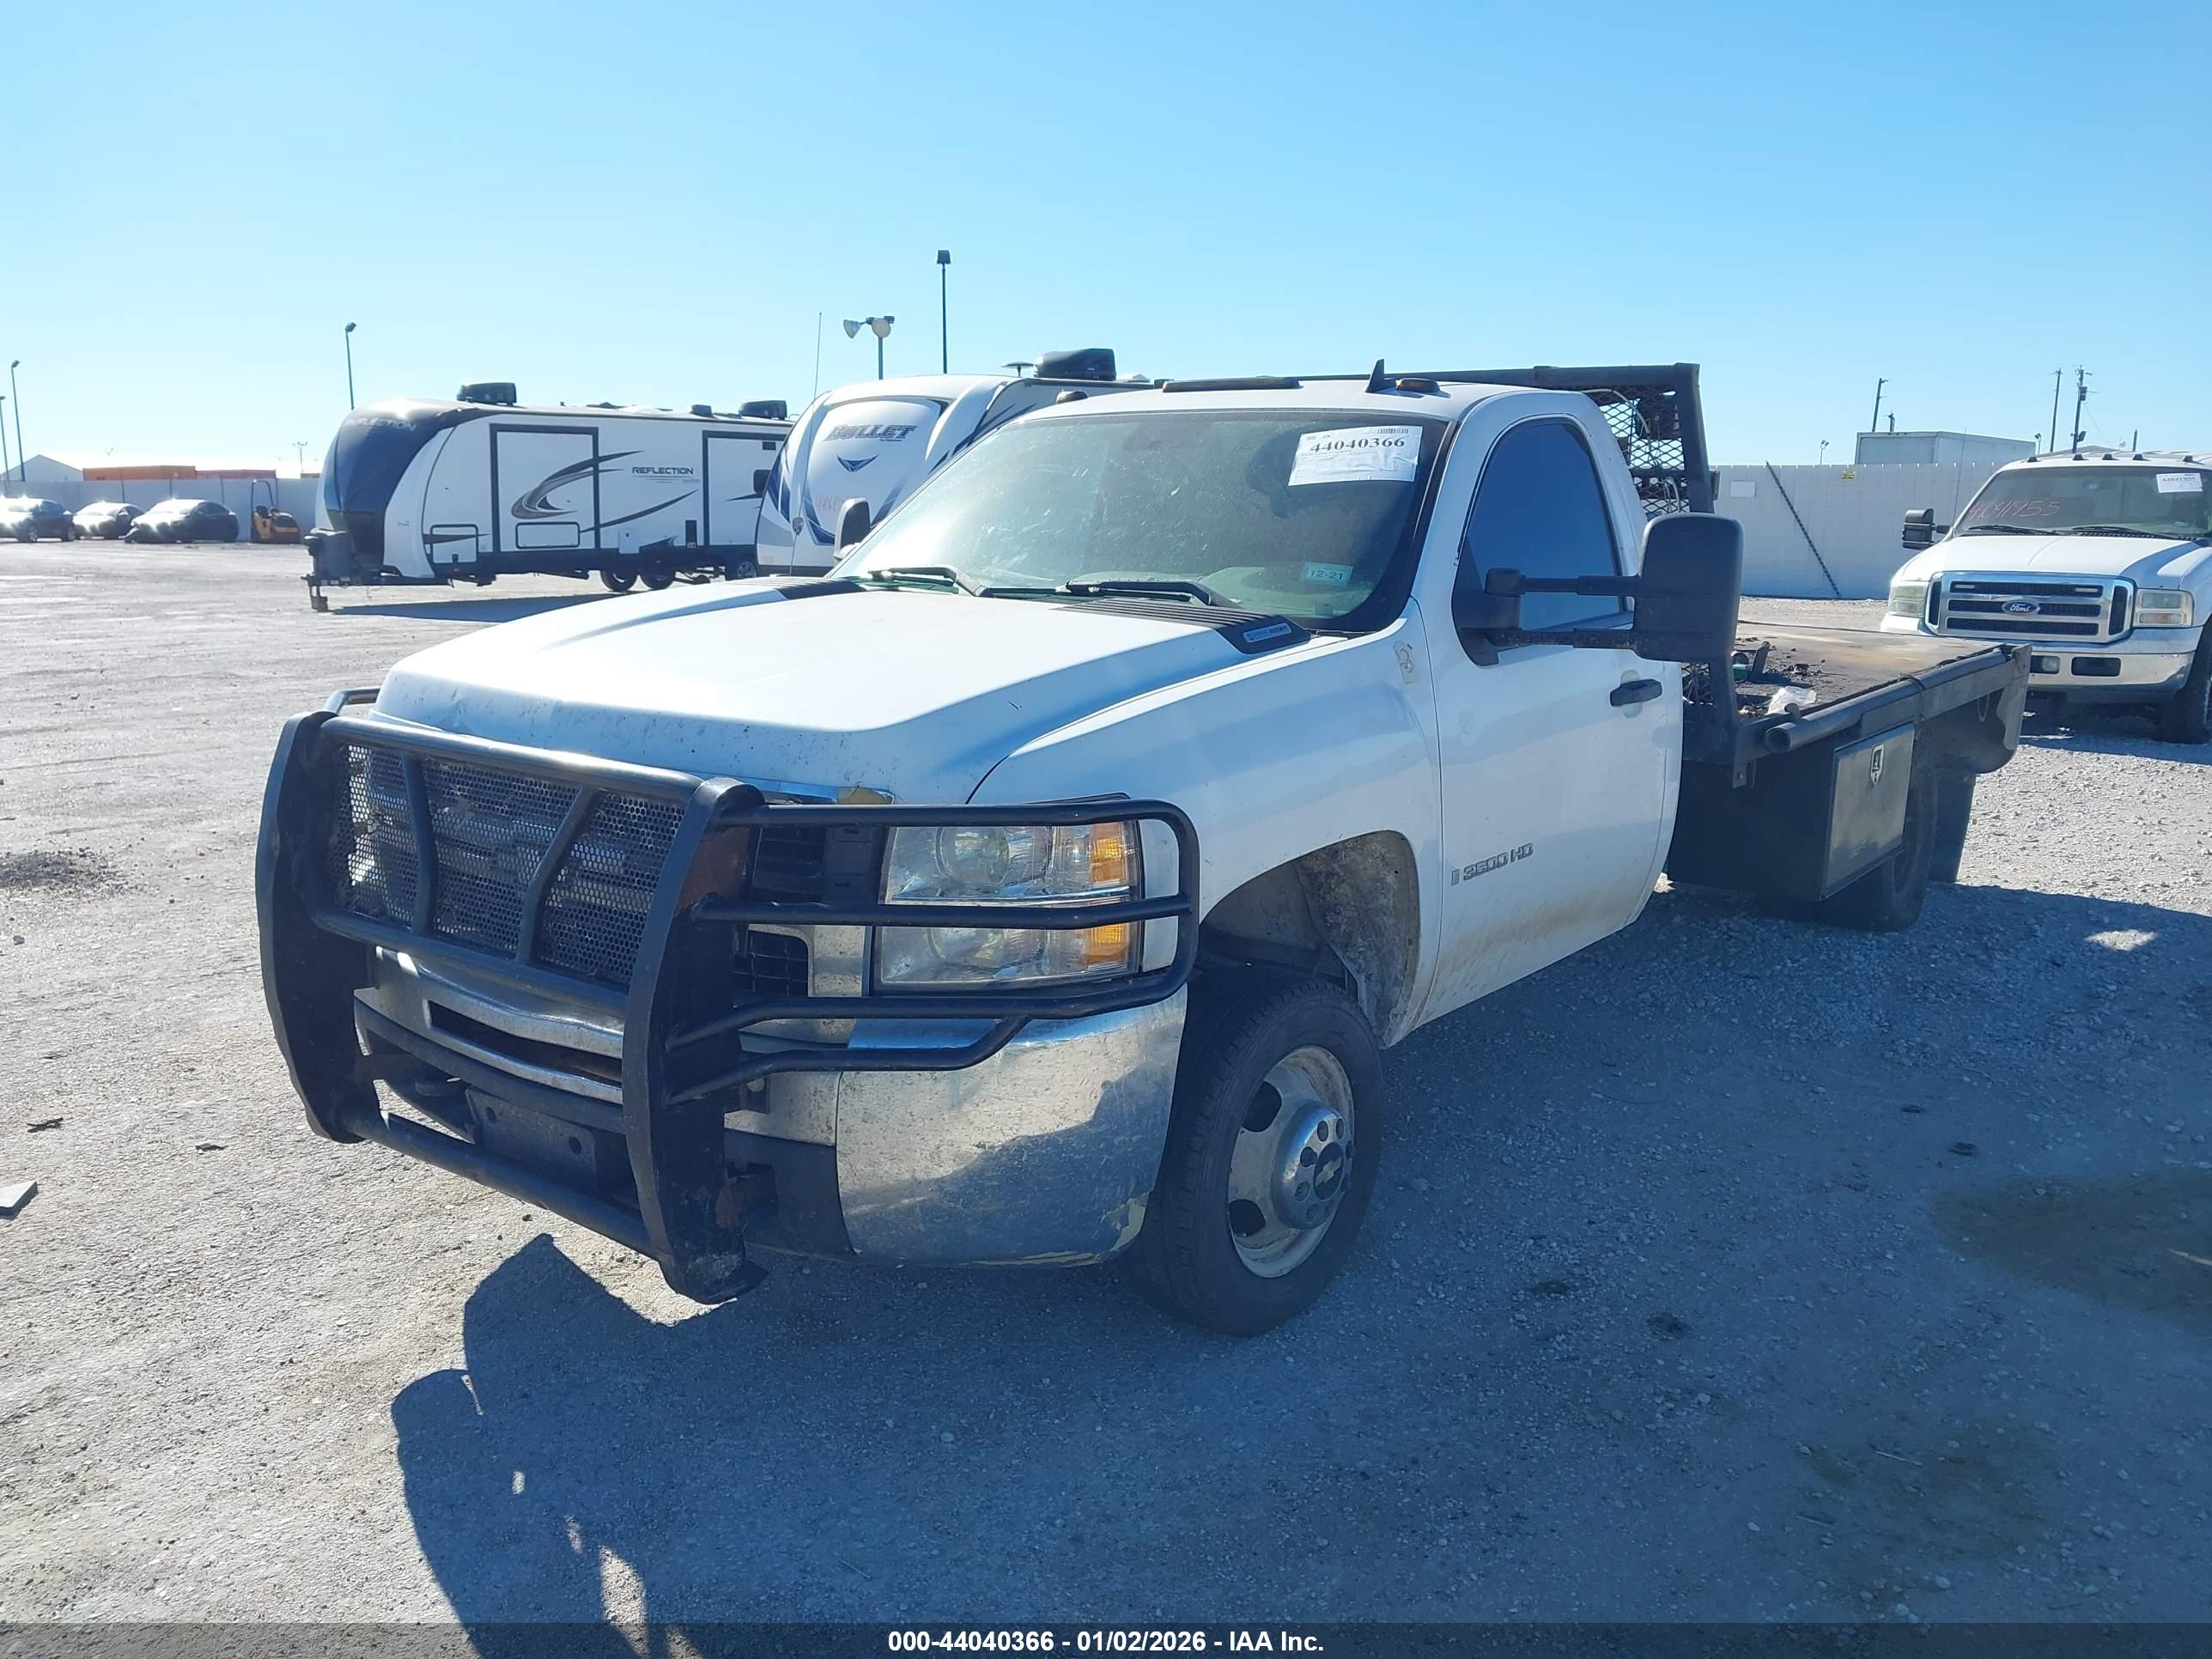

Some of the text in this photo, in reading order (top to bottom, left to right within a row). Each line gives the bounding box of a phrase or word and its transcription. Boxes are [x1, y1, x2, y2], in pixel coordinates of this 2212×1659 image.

[823, 424, 918, 441] BULLET
[1309, 436, 1407, 453] 44040366
[632, 466, 694, 475] REFLECTION
[2009, 603, 2032, 612] Ford
[1510, 842, 1534, 864] HD
